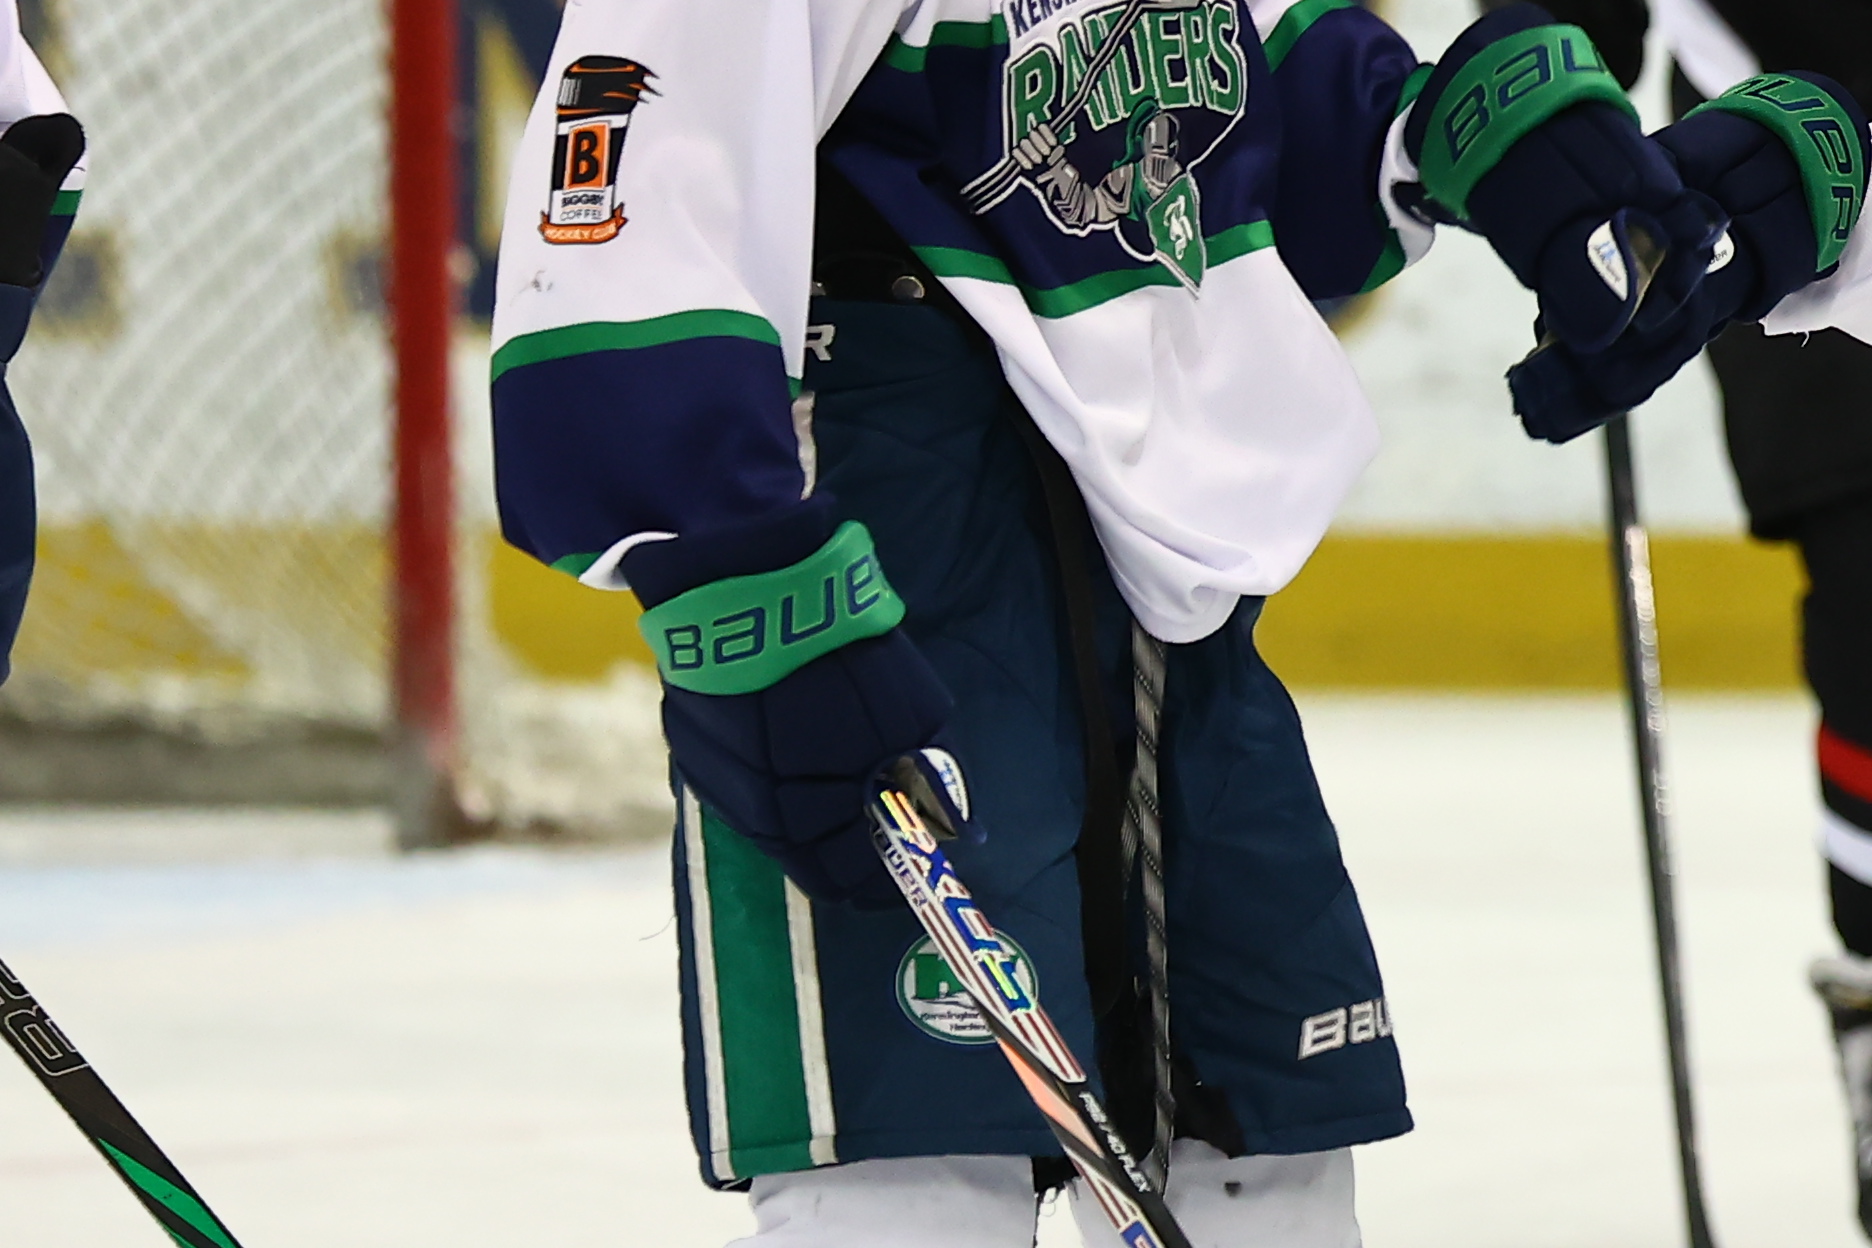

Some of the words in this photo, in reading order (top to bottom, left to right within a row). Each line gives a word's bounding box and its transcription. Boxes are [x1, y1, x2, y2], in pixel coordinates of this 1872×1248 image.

[572, 130, 599, 185] B
[1443, 38, 1611, 165] BAU
[664, 554, 882, 671] BAUE
